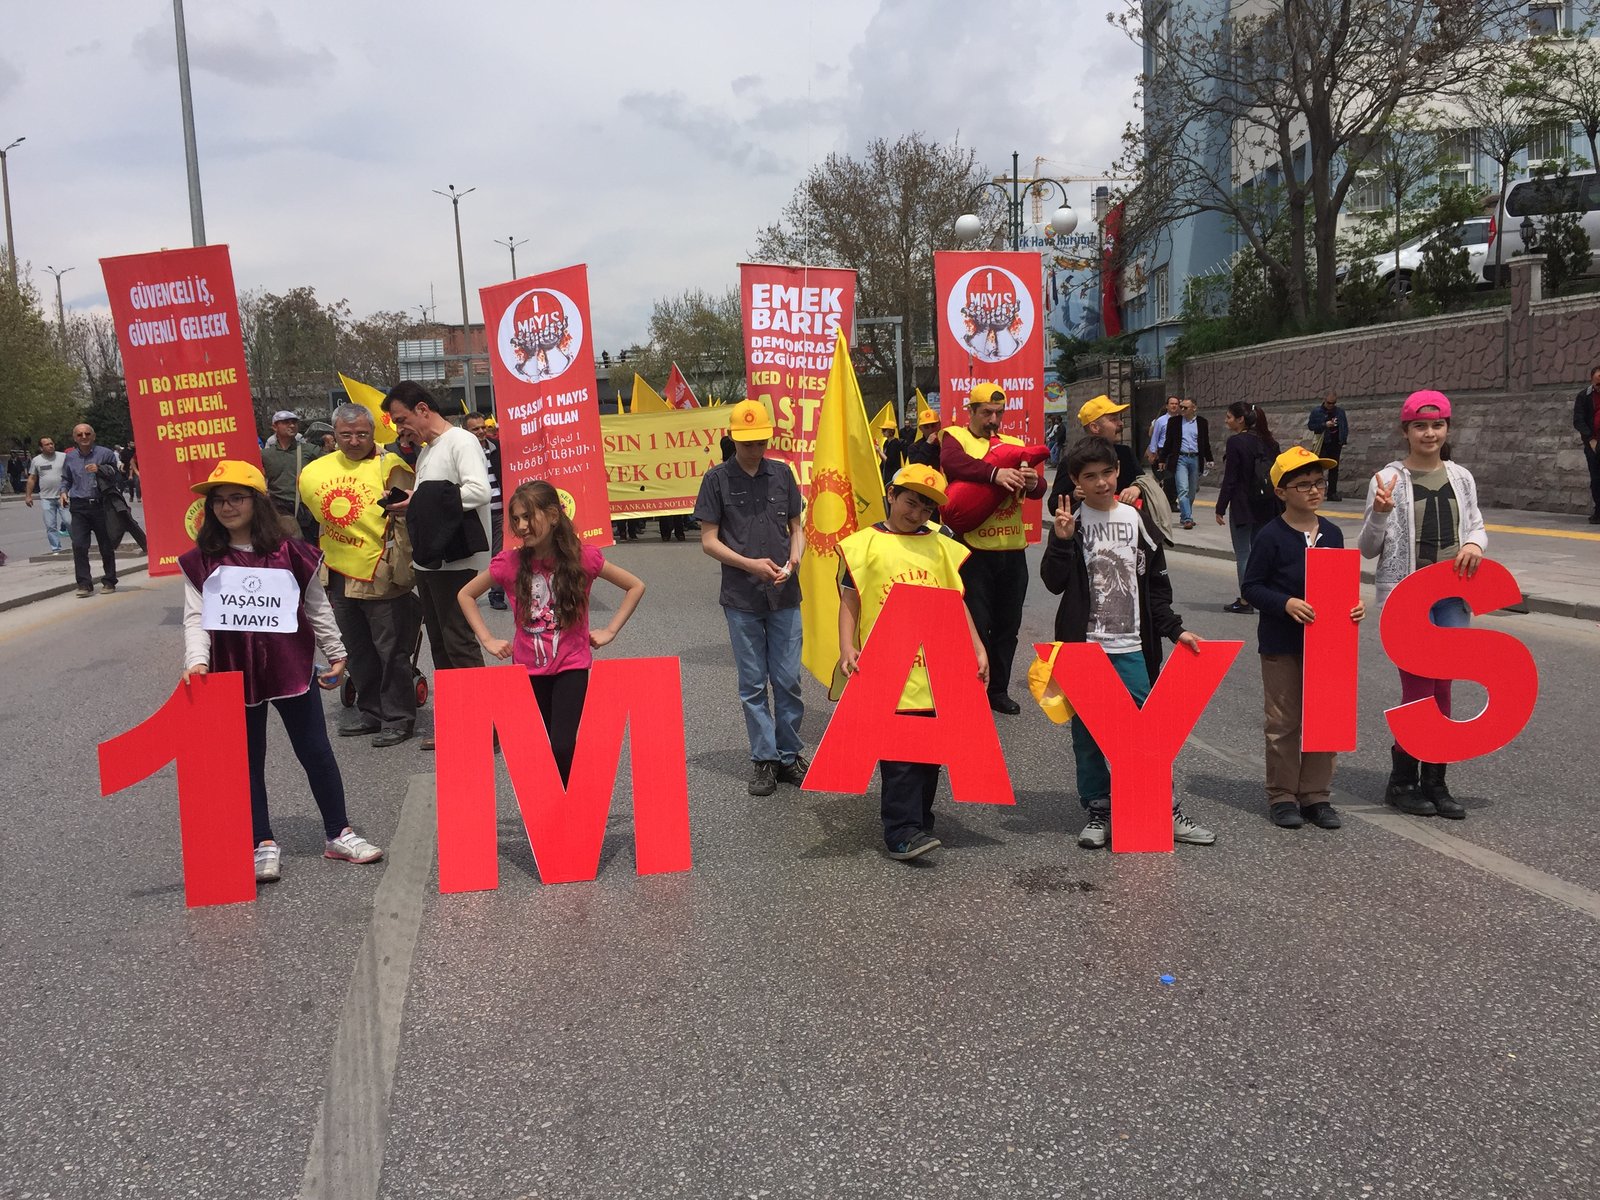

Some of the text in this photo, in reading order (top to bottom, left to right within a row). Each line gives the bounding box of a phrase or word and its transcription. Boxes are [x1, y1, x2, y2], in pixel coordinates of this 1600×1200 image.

[986, 272, 993, 291] 1
[130, 275, 214, 310] GÜVENCELİ İŞ,
[752, 283, 844, 313] EMEK
[970, 292, 1013, 308] MAYIS
[532, 295, 539, 313] 1
[128, 312, 230, 347] GÜVENLİ GELECEK
[517, 311, 560, 334] MAYIS
[751, 308, 841, 340] BARIŞ
[751, 336, 835, 354] DEMOKRAS
[151, 376, 171, 394] BO
[173, 368, 237, 391] XEBATEKE
[751, 371, 781, 386] KED
[1003, 377, 1034, 391] MAYIS
[159, 400, 174, 417] BI
[507, 388, 589, 420] YAŞASIN 1 MAYIS
[543, 409, 579, 426] GULAN
[157, 416, 237, 442] PÊŞEROJEKE
[649, 433, 658, 450] 1
[175, 442, 226, 463] BI EWLE
[563, 464, 583, 475] MAY
[624, 502, 656, 511] ANKARA
[583, 528, 603, 540] ŞUBE
[1081, 521, 1133, 542] WANTED
[220, 594, 281, 608] YAŞASIN
[220, 613, 279, 627] 1 MAYIS
[99, 671, 257, 906] 1
